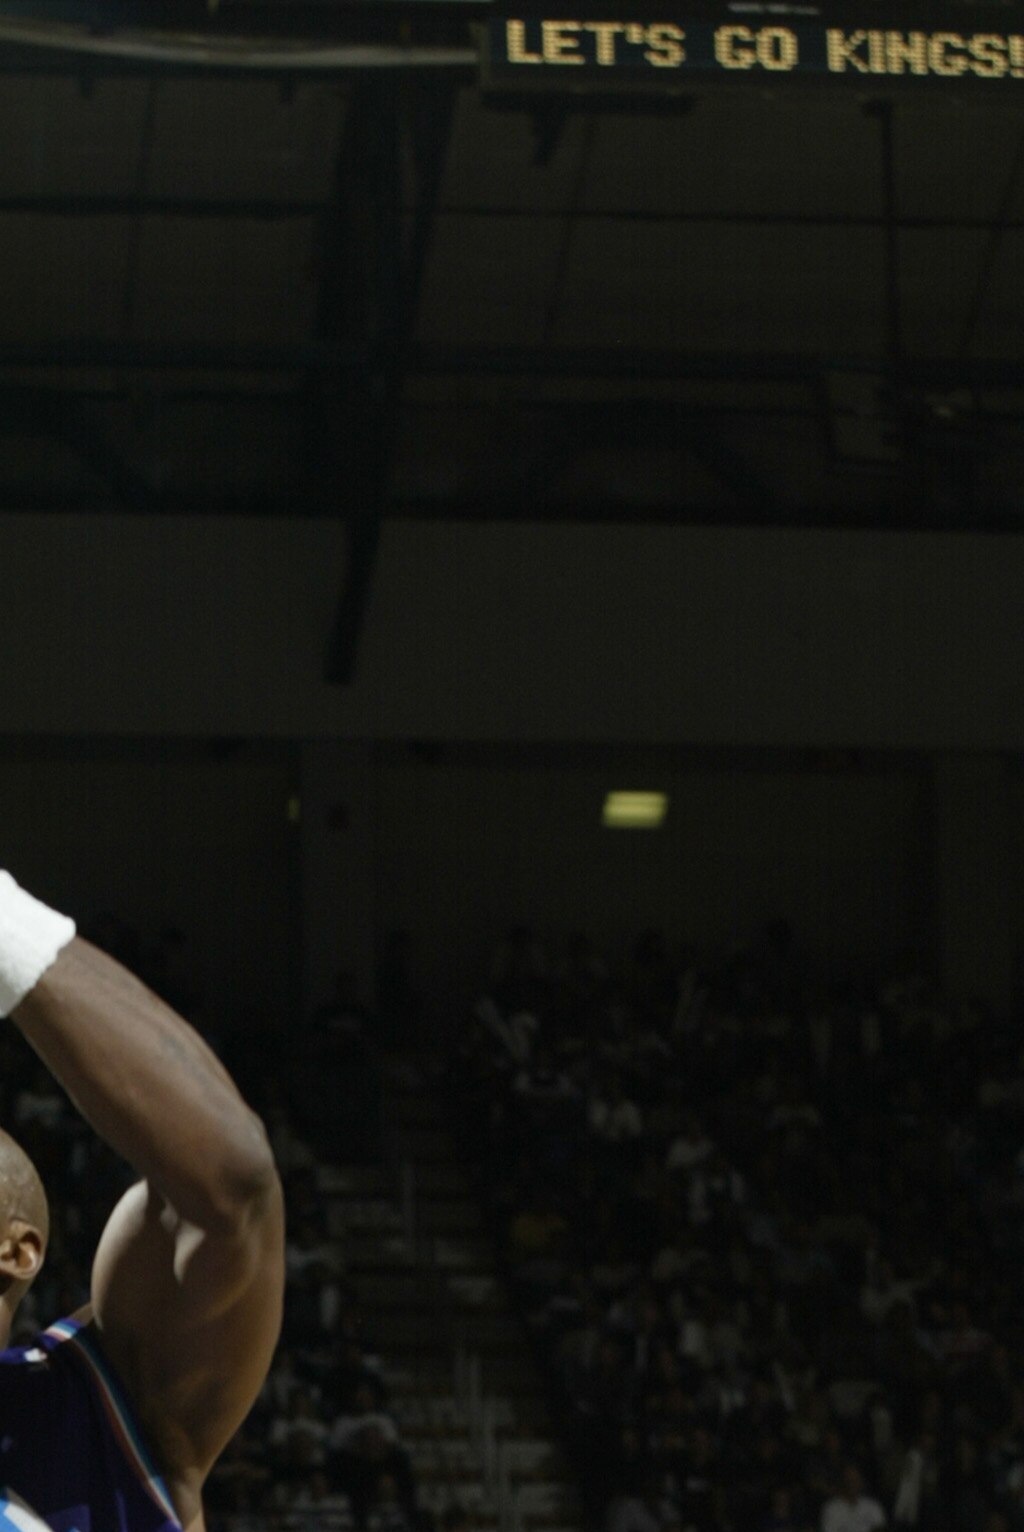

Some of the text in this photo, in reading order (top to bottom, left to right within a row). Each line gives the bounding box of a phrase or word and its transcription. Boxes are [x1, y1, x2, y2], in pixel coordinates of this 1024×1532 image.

[506, 19, 1024, 79] LET'S GO KINGS!
